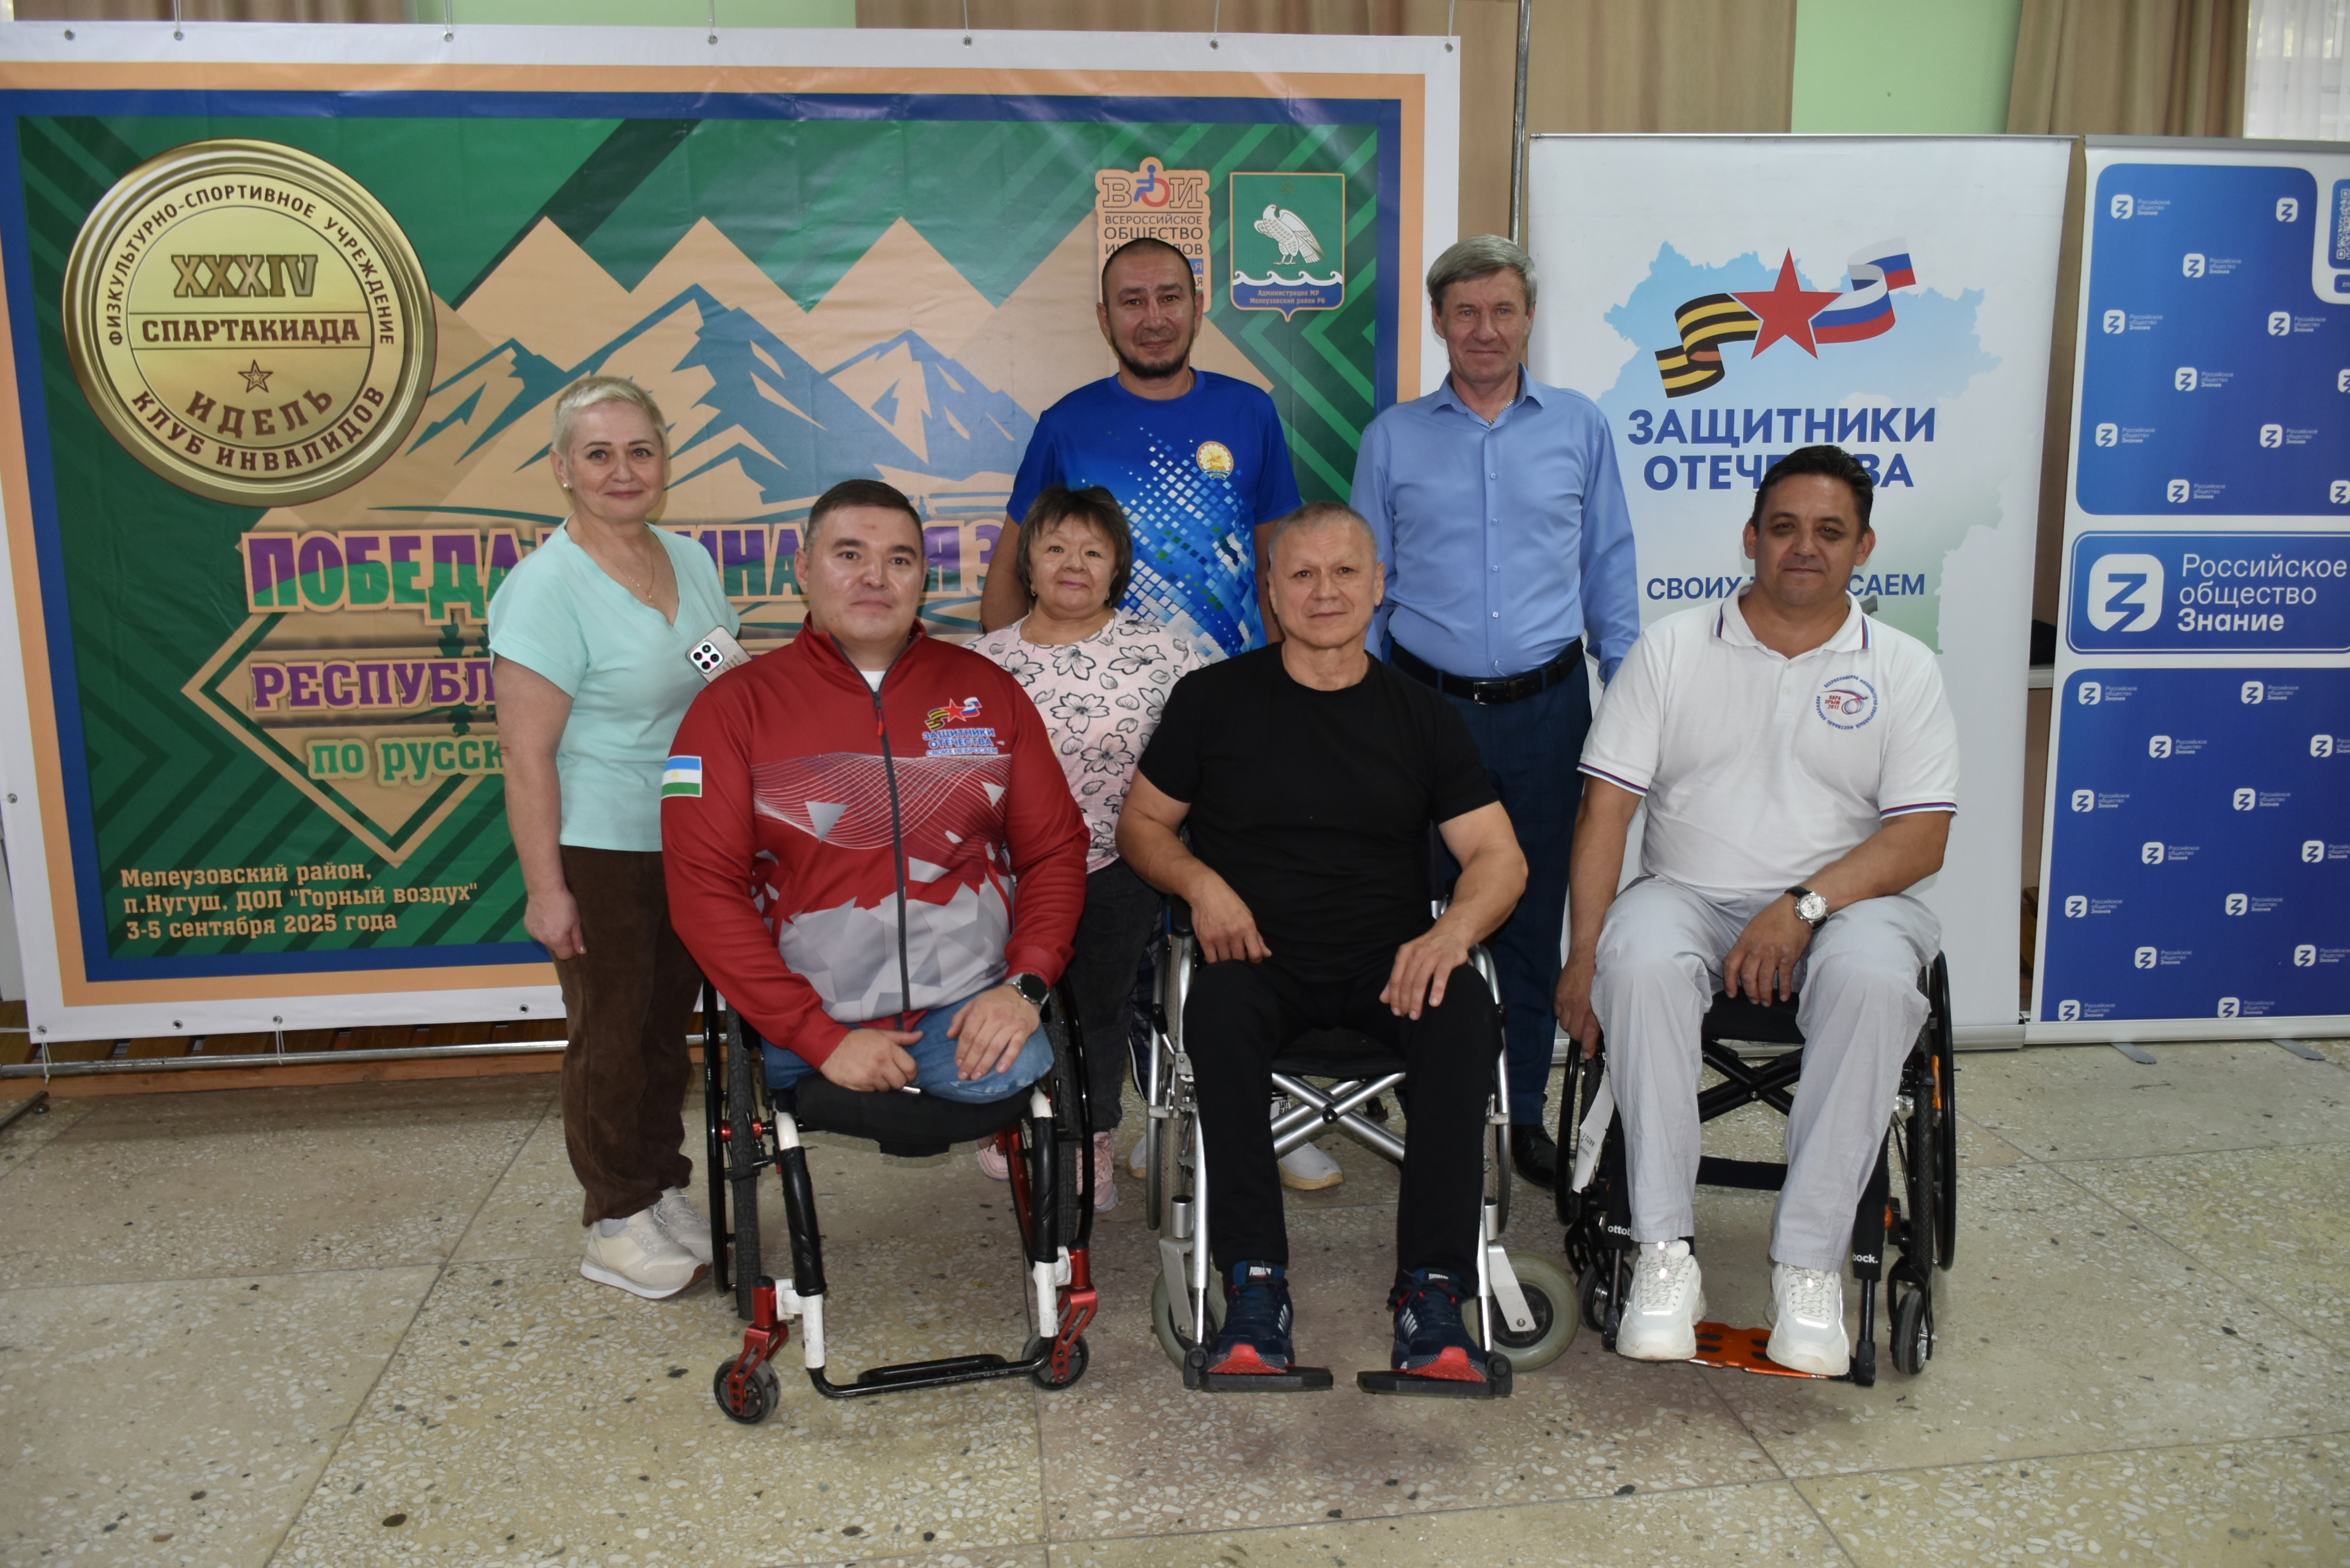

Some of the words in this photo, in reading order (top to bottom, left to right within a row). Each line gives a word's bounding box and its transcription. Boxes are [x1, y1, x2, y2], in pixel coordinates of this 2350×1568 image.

[1104, 213, 1202, 225] ВСЕРОССИЙСКОЕ
[1104, 227, 1203, 239] ОБЩЕСТВО
[106, 185, 316, 345] ФИЗКУЛЬТУРНО-СПОРТИВНОЕ
[324, 217, 394, 344] УЧРЕЖДЕНИЕ
[171, 255, 318, 297] XXXIV
[142, 319, 360, 344] СПАРТАКИАДА
[186, 389, 333, 439] ИДЕЛЬ
[132, 391, 205, 455] КЛУБ
[215, 386, 384, 470] ИНВАЛИДОВ
[1628, 407, 1936, 448] ЗАЩИТНИКИ
[1643, 453, 1914, 491] ОТЕЧВА
[246, 532, 524, 622] ПОБЕДА
[2182, 553, 2347, 578] Российское
[1846, 573, 1925, 596] САЕМ
[2179, 581, 2317, 608] общество
[2177, 608, 2285, 631] Знание
[251, 661, 496, 709] РЕСПУБЛ
[922, 728, 996, 741] ЗАЩИТНИКИ
[928, 737, 994, 748] ОТЕЧЕСТВА
[312, 744, 364, 775] по
[382, 740, 505, 781] русск
[926, 748, 953, 757] СВОИХ
[121, 864, 289, 890] Мелеузовский
[297, 862, 372, 885] район,
[124, 894, 228, 918] п.Нугуш,
[236, 890, 283, 913] ДОЛ
[290, 885, 386, 910] "Горный
[393, 883, 478, 905] воздух"
[126, 921, 162, 940] 3-5
[169, 916, 276, 939] сентября
[283, 914, 337, 933] 2025
[345, 914, 397, 931] года
[1607, 1225, 1631, 1236] ottob
[1853, 1253, 1878, 1264] bock.
